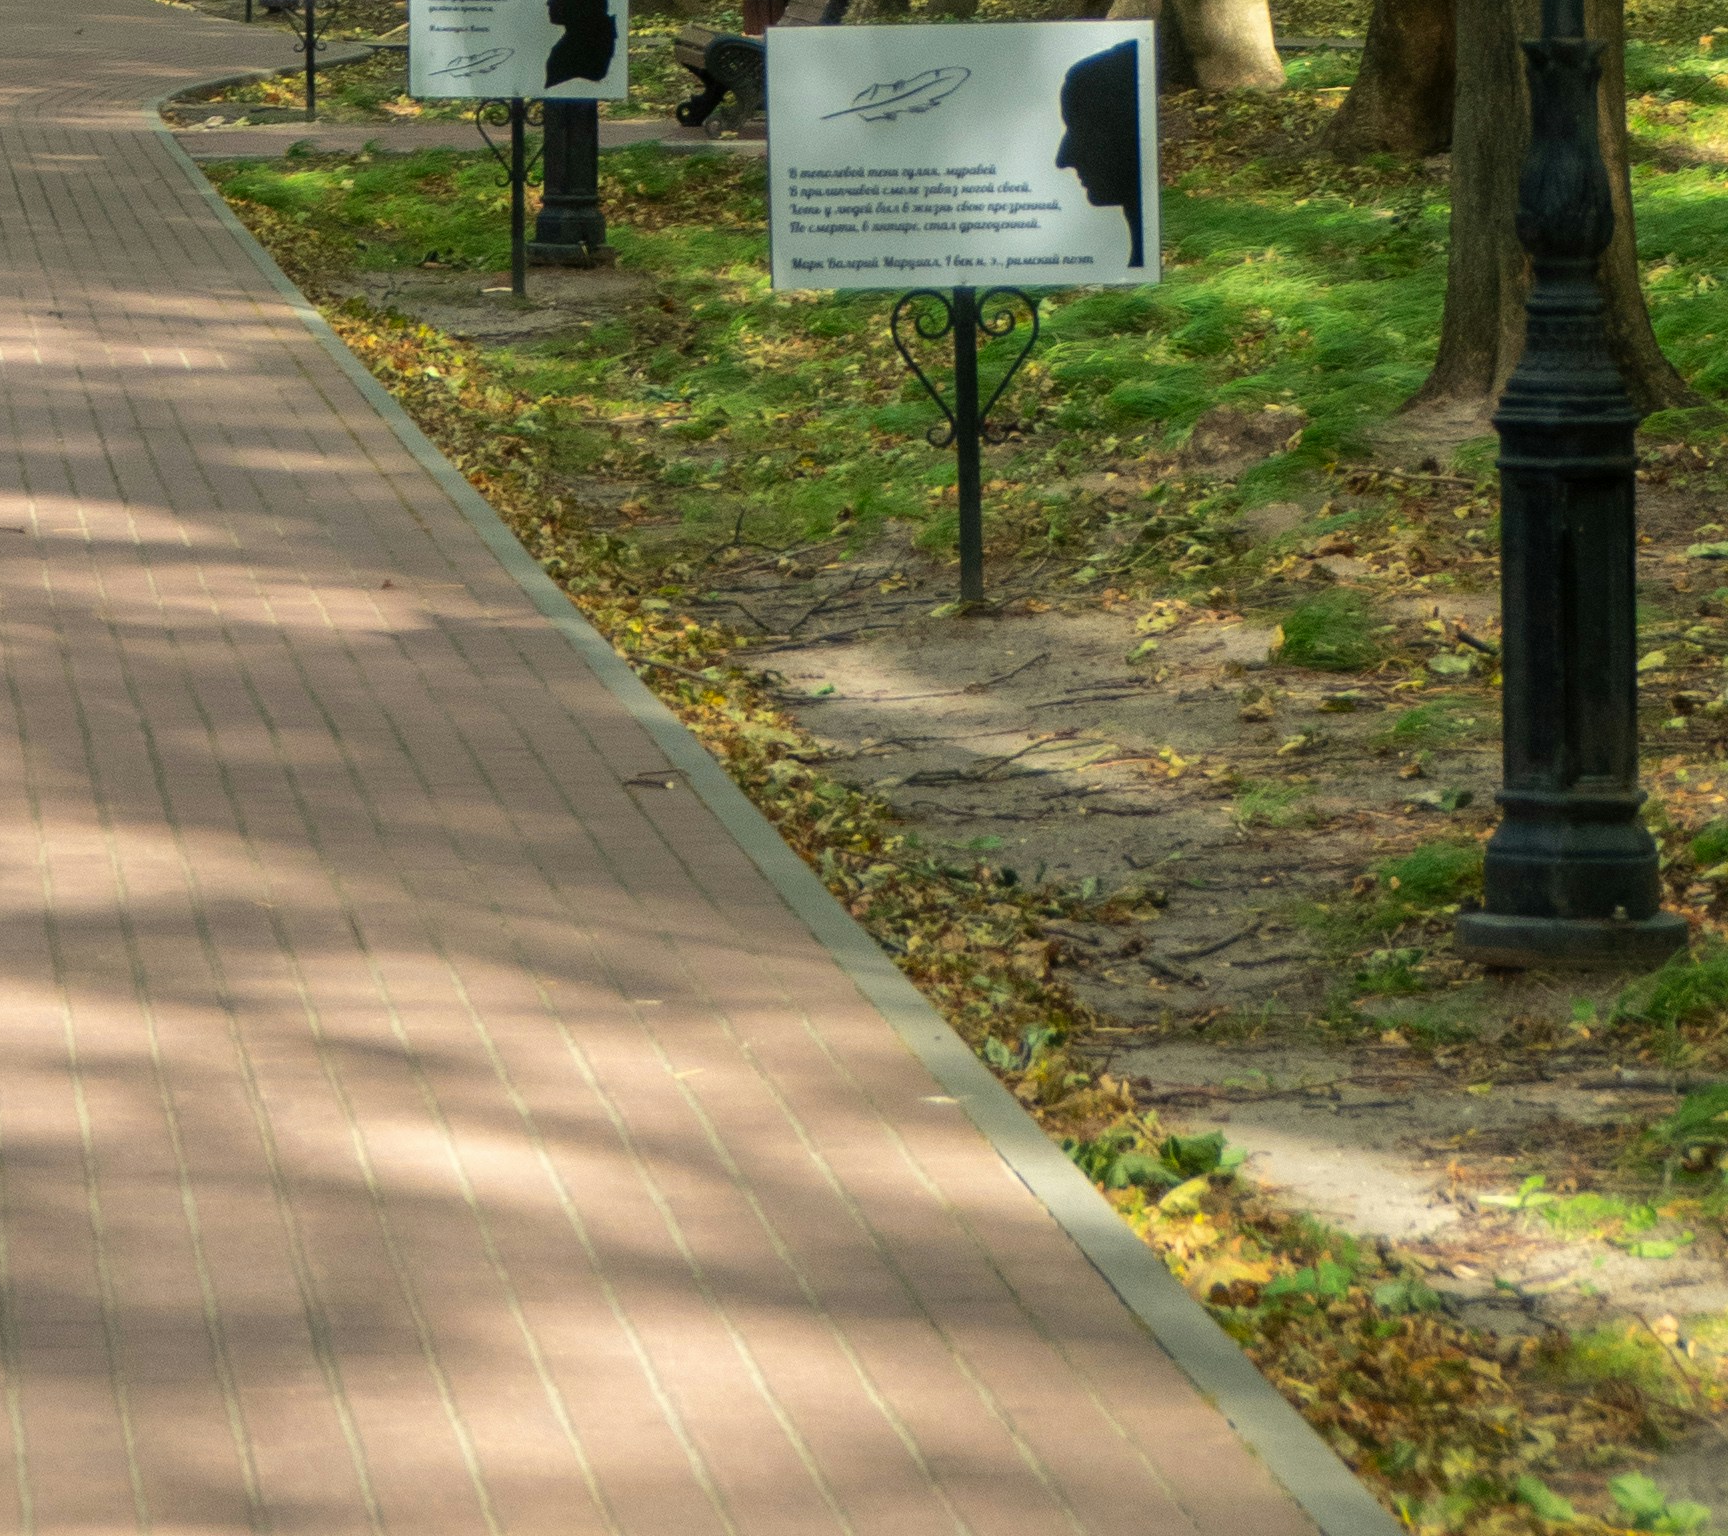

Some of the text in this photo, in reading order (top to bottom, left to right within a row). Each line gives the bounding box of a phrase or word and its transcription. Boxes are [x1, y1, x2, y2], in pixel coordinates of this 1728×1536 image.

[788, 167, 797, 178] В
[800, 167, 864, 178] тополевой
[868, 168, 899, 178] тени
[943, 164, 996, 179] муравей
[789, 185, 798, 197] В
[800, 183, 879, 199] прилипчивой
[882, 186, 920, 196] смоле
[924, 182, 958, 198] завяз
[961, 182, 994, 194] ногой
[824, 206, 831, 217] у
[835, 203, 873, 218] людей
[875, 202, 900, 215] был
[902, 202, 909, 214] в
[912, 204, 953, 216] жизнь
[956, 201, 985, 213] свою
[924, 221, 956, 231] стал
[792, 257, 824, 272] Марк
[827, 256, 879, 271] Валерий
[954, 255, 973, 267] век
[1005, 254, 1060, 268] римский
[1063, 254, 1094, 265] поэт
